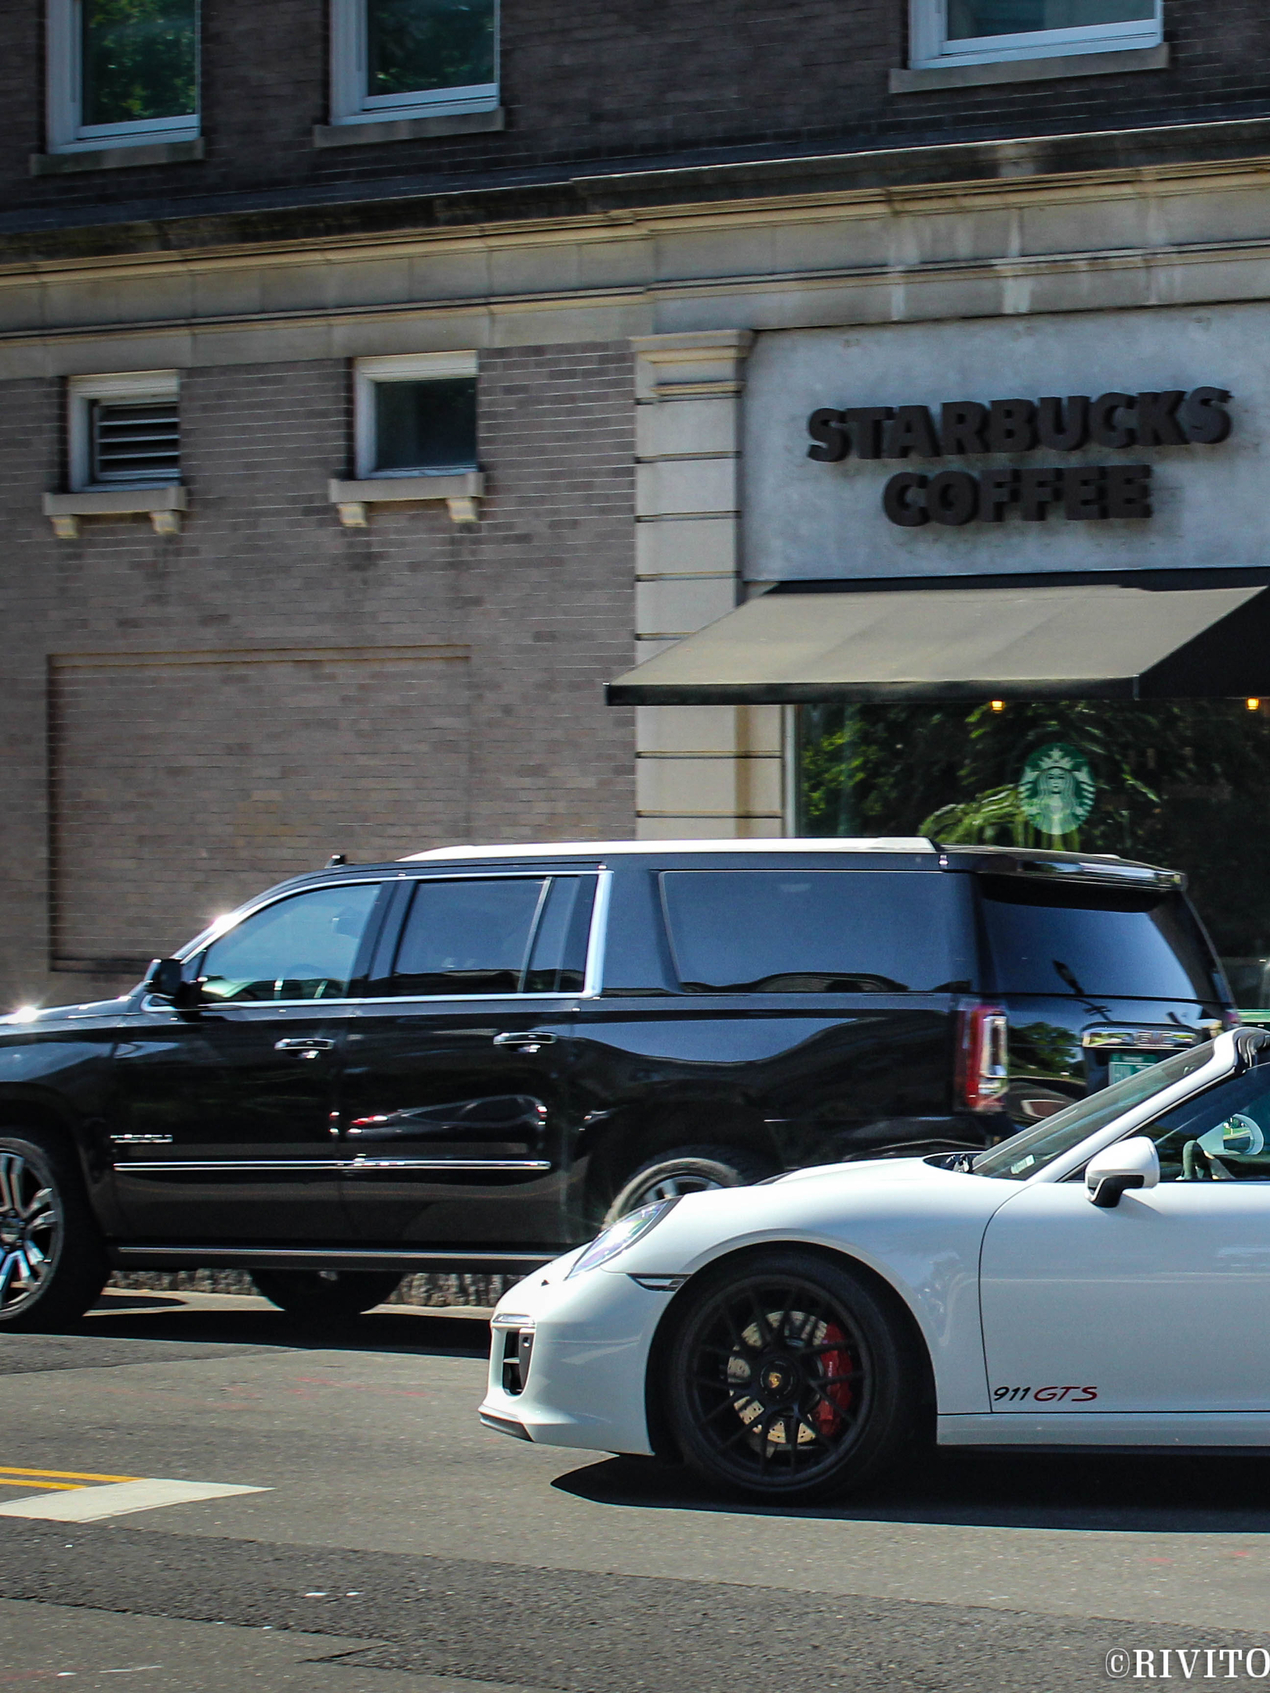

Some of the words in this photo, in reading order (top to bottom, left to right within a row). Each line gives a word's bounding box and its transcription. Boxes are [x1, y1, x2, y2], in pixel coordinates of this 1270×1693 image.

[807, 386, 1234, 462] STARBUCKS
[882, 464, 1154, 527] COFFEE
[994, 1386, 1031, 1401] 911
[1033, 1386, 1098, 1402] GTS
